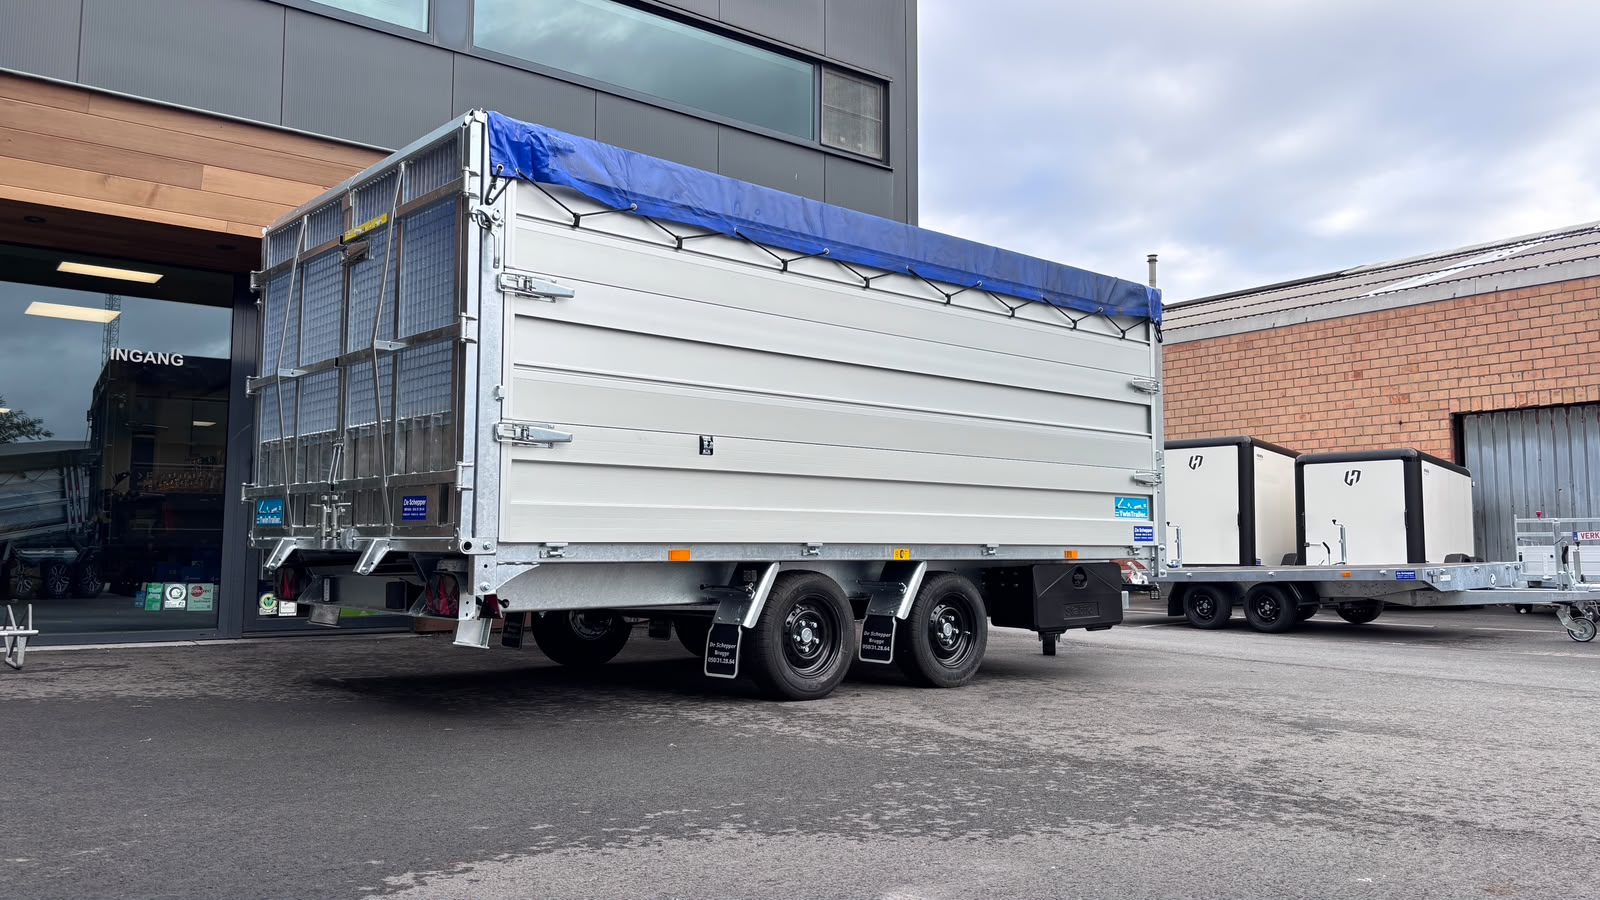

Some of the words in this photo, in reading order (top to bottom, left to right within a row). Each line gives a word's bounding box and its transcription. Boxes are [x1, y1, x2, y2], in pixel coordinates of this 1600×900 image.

[110, 347, 184, 367] INGANG
[868, 637, 885, 645] Brugge
[716, 642, 736, 650] Schepper
[714, 649, 730, 657] Brugge
